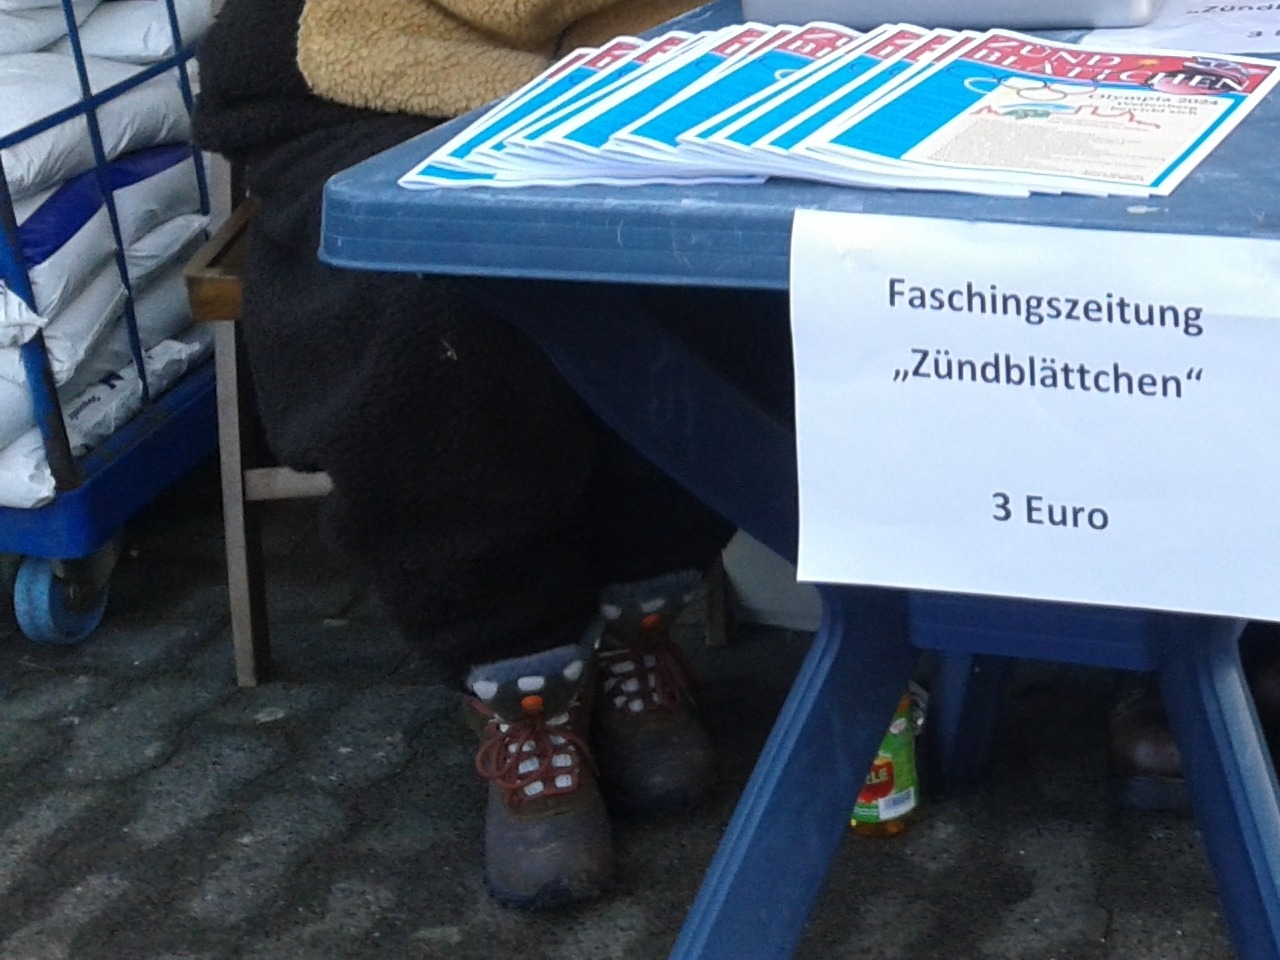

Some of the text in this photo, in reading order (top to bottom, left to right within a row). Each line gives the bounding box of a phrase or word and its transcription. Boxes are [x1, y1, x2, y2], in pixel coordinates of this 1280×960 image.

[973, 48, 1250, 91] BLÄTTCHEN
[987, 40, 1122, 66] ZÜND
[887, 276, 1204, 337] Faschingszeitung
[892, 346, 1204, 399] „Zündblättchen“
[991, 492, 1110, 531] 3 Euro
